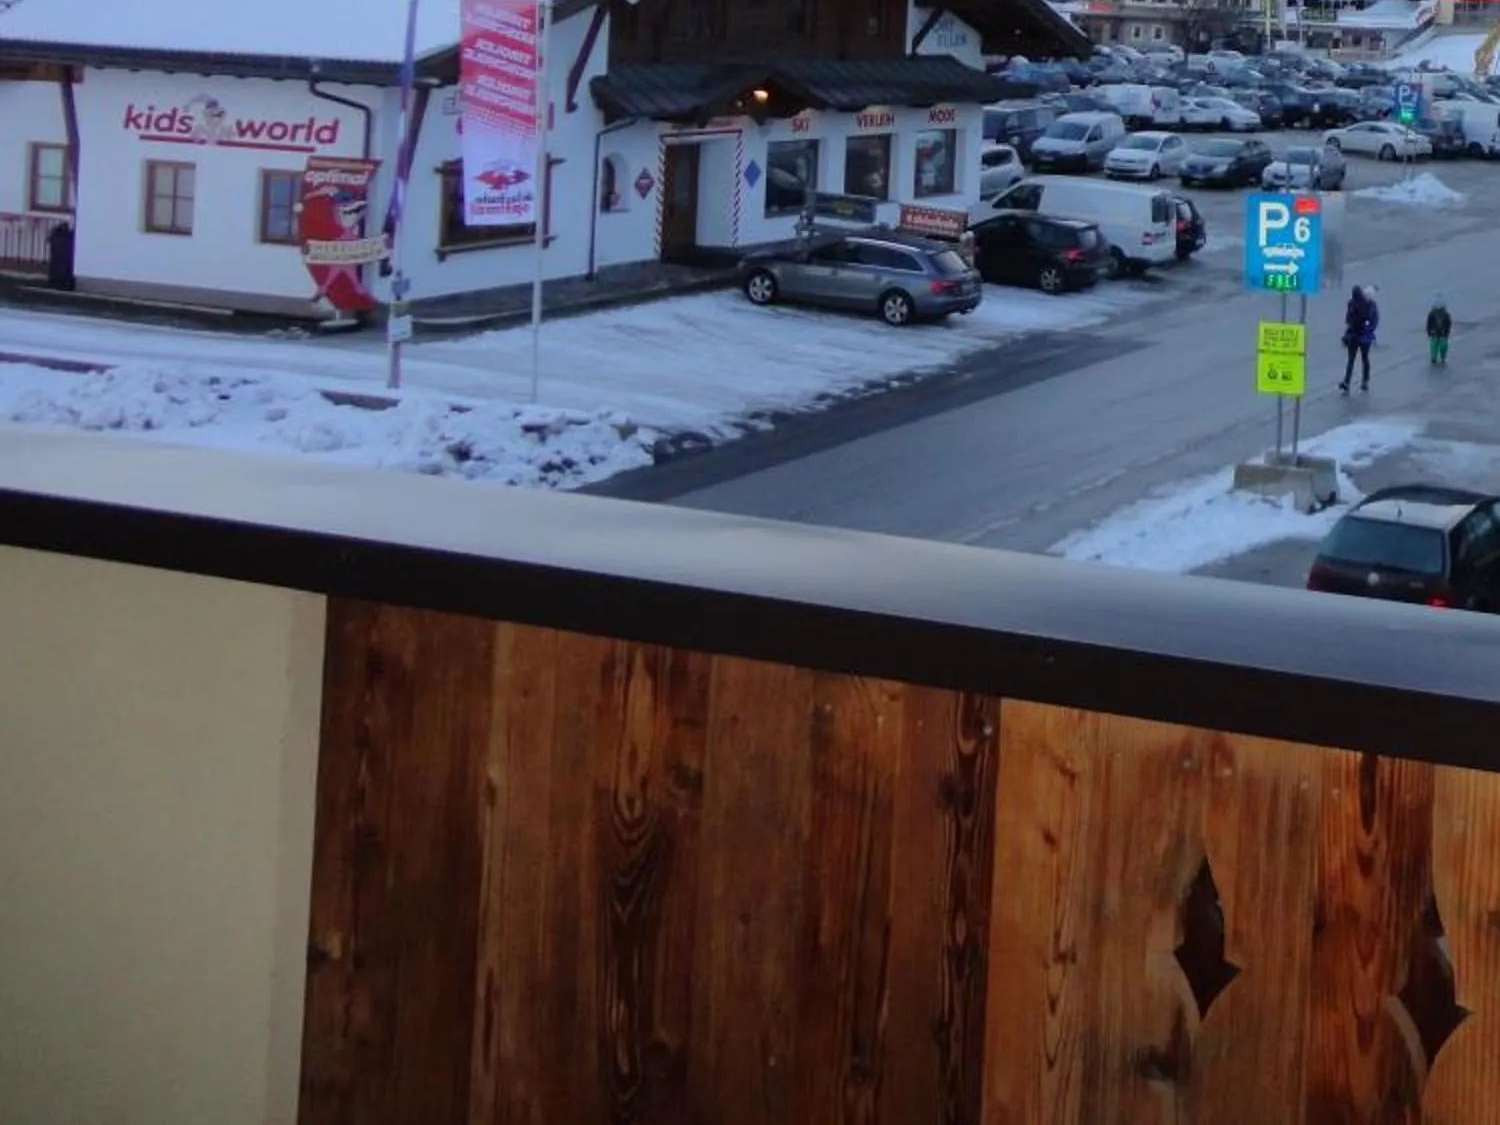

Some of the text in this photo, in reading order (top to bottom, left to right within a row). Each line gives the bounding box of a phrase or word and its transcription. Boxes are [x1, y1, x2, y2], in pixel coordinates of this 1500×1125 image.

[123, 104, 340, 145] kids world
[1259, 201, 1311, 248] P 6
